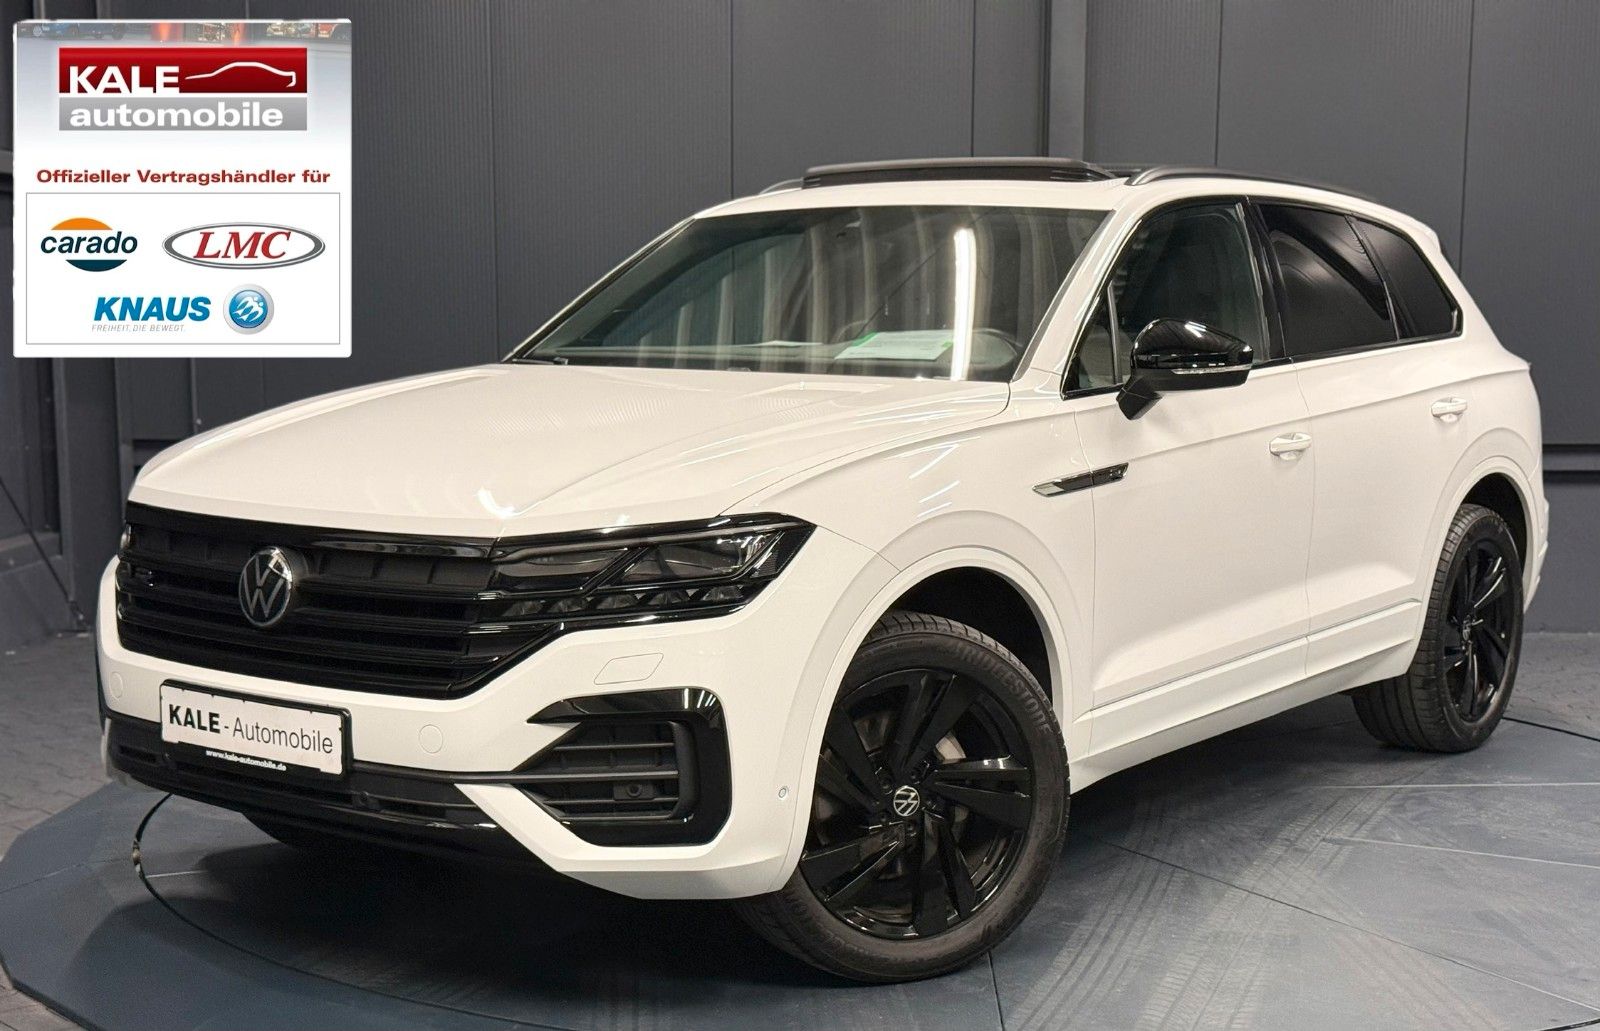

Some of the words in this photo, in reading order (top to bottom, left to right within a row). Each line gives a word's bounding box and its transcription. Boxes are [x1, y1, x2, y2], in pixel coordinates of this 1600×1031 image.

[169, 704, 220, 734] KALE
[233, 717, 334, 755] Automobile
[206, 750, 287, 772] www.kale-automobile.de
